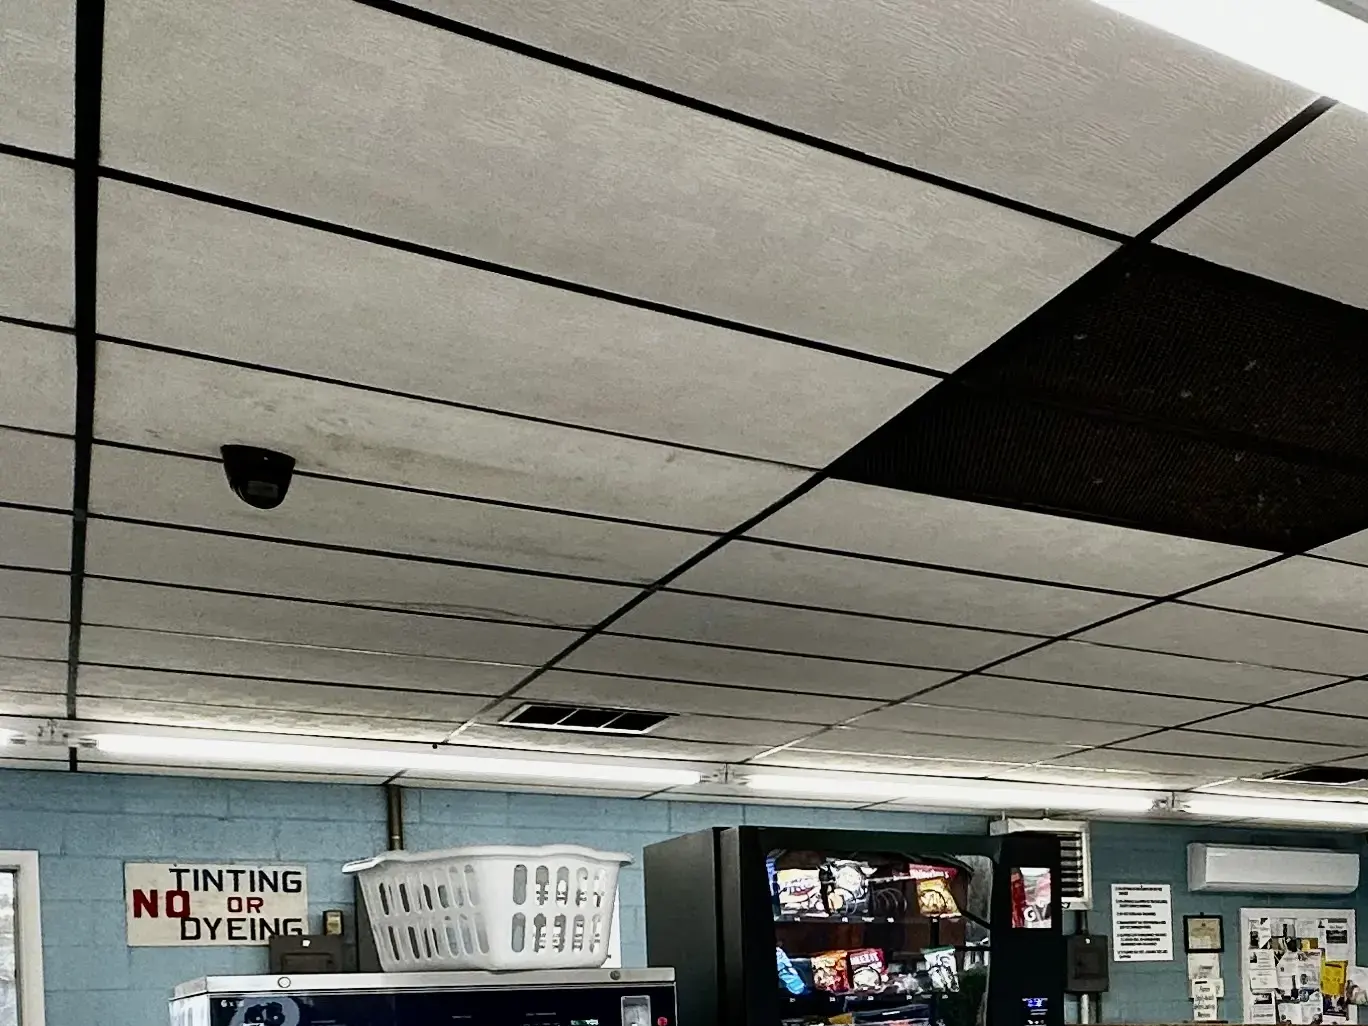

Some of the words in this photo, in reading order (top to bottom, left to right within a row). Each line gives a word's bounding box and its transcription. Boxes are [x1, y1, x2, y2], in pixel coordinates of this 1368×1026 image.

[169, 869, 301, 893] TINTING
[133, 889, 190, 918] NO
[227, 897, 264, 913] OR
[181, 918, 303, 941] DYEING
